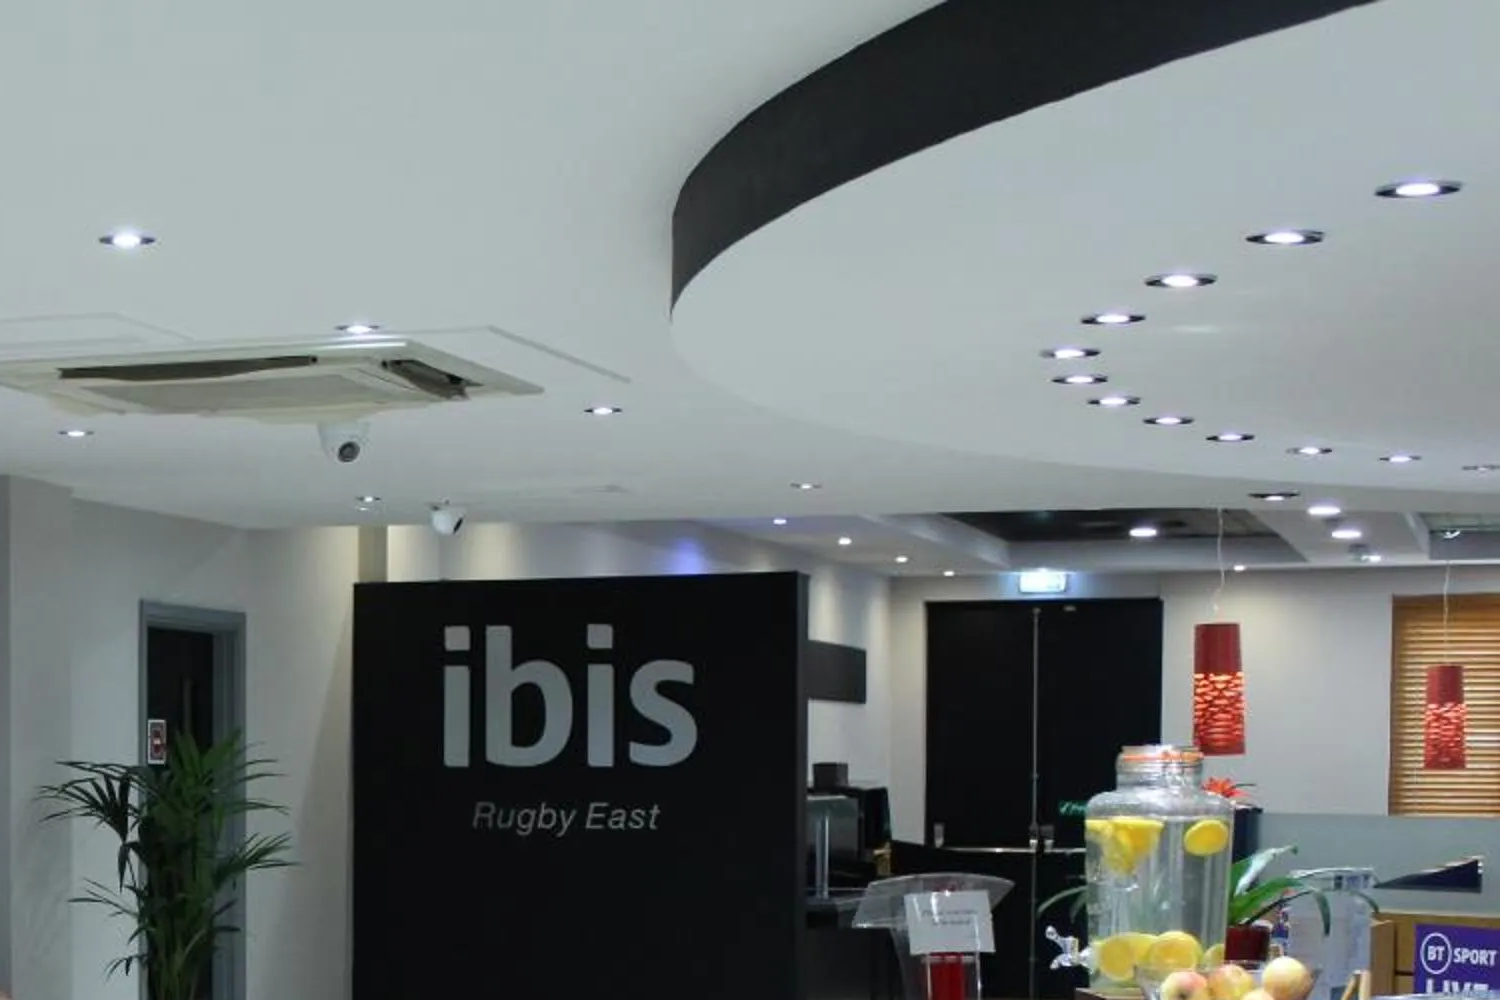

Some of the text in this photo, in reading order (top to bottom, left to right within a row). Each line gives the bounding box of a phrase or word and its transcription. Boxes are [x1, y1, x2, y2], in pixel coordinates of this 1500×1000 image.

[443, 624, 698, 767] ibis
[472, 801, 661, 837] Rugby East
[1427, 946, 1497, 967] BT SPORT
